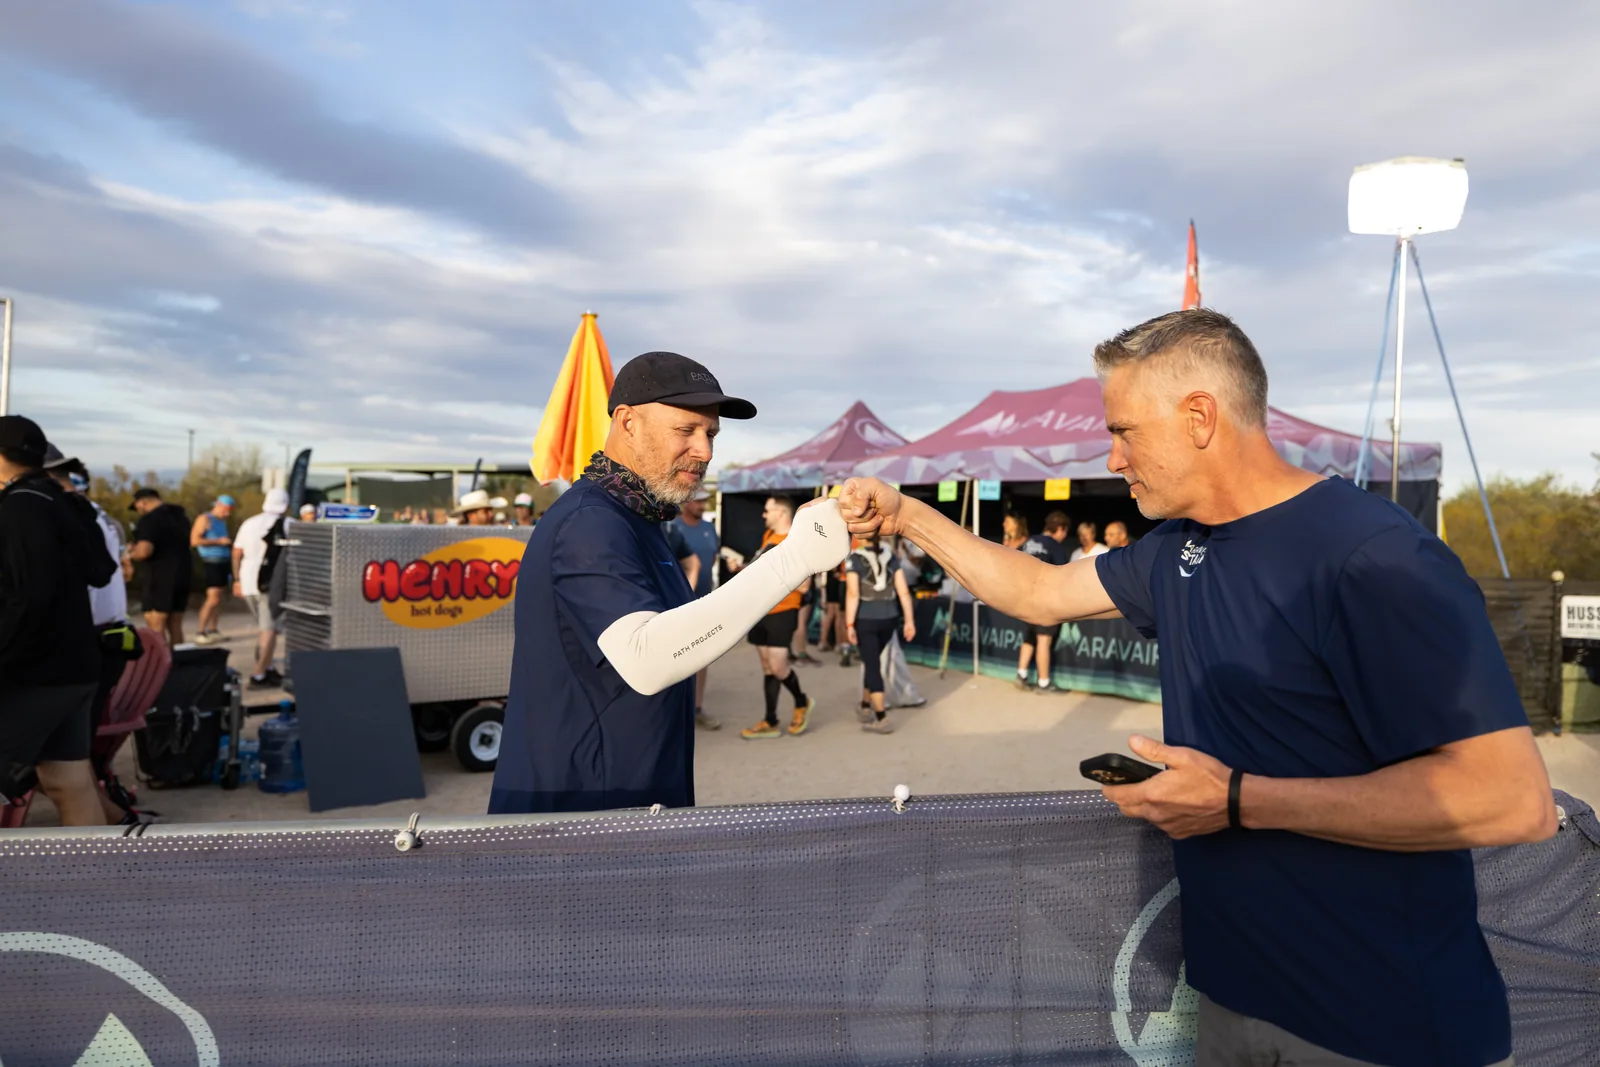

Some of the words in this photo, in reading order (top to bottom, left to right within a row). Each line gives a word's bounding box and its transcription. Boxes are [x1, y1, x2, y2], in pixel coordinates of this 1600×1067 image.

[363, 558, 520, 603] HENRY
[410, 604, 431, 617] hot
[435, 604, 463, 619] dogs
[672, 645, 691, 660] PATH
[690, 624, 723, 648] PROJECTS
[950, 623, 1025, 651] ARVAIPA
